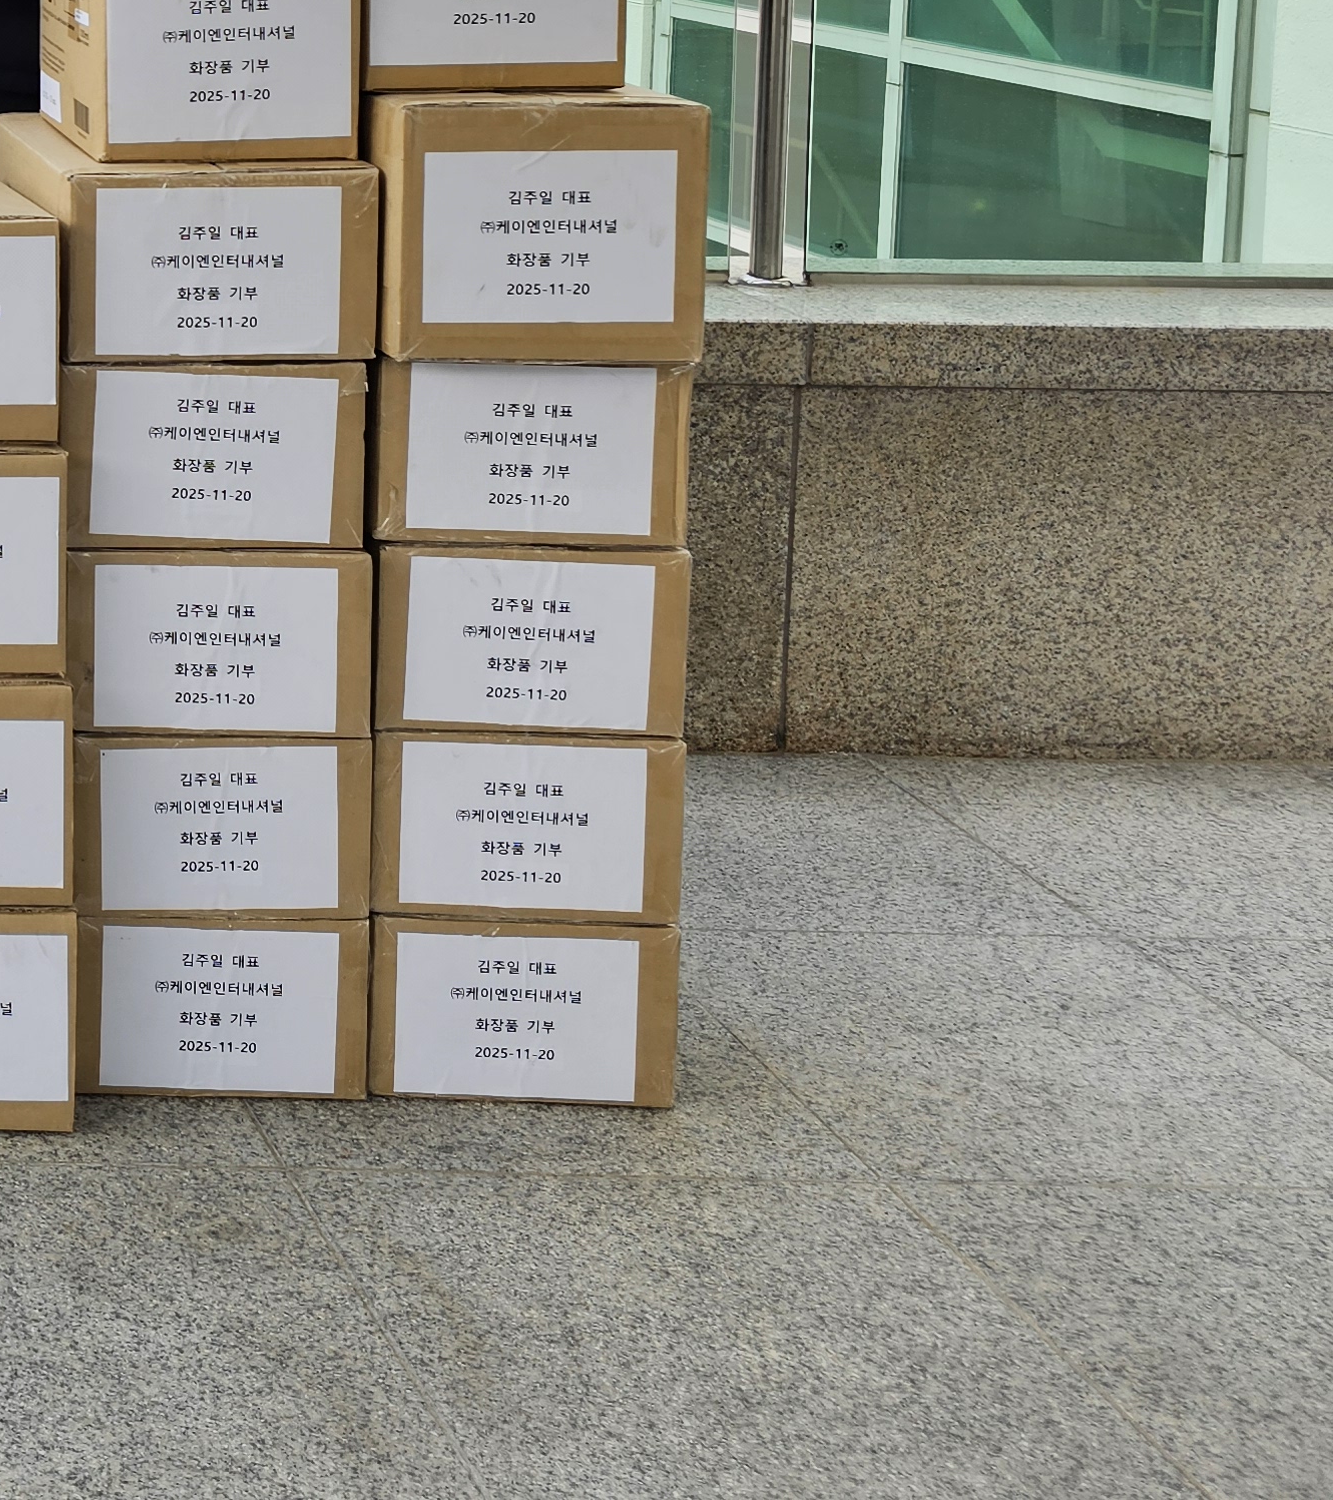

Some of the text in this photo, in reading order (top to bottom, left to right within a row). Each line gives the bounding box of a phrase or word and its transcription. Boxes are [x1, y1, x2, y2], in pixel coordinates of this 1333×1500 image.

[190, 0, 270, 14] 김주일 대표
[454, 12, 535, 24] 2025-11-20
[189, 59, 270, 75] 화장품 기부
[190, 89, 270, 102] 2025-11-20
[509, 191, 591, 205] 김주일 대표
[506, 253, 590, 267] 화장품 기부
[507, 283, 590, 295] 2025-11-20
[177, 399, 256, 414] 김주일 대표
[173, 458, 253, 474] 화장품 기부
[172, 488, 251, 501] 2025-11-20
[484, 782, 564, 798] 김주일 대표
[481, 841, 562, 857] 화장품 기부
[481, 870, 561, 883] 2025-11-20
[478, 960, 557, 975] 김주일 대표
[475, 1018, 555, 1034] 화장품 기부
[475, 1047, 554, 1060] 2025-11-20
